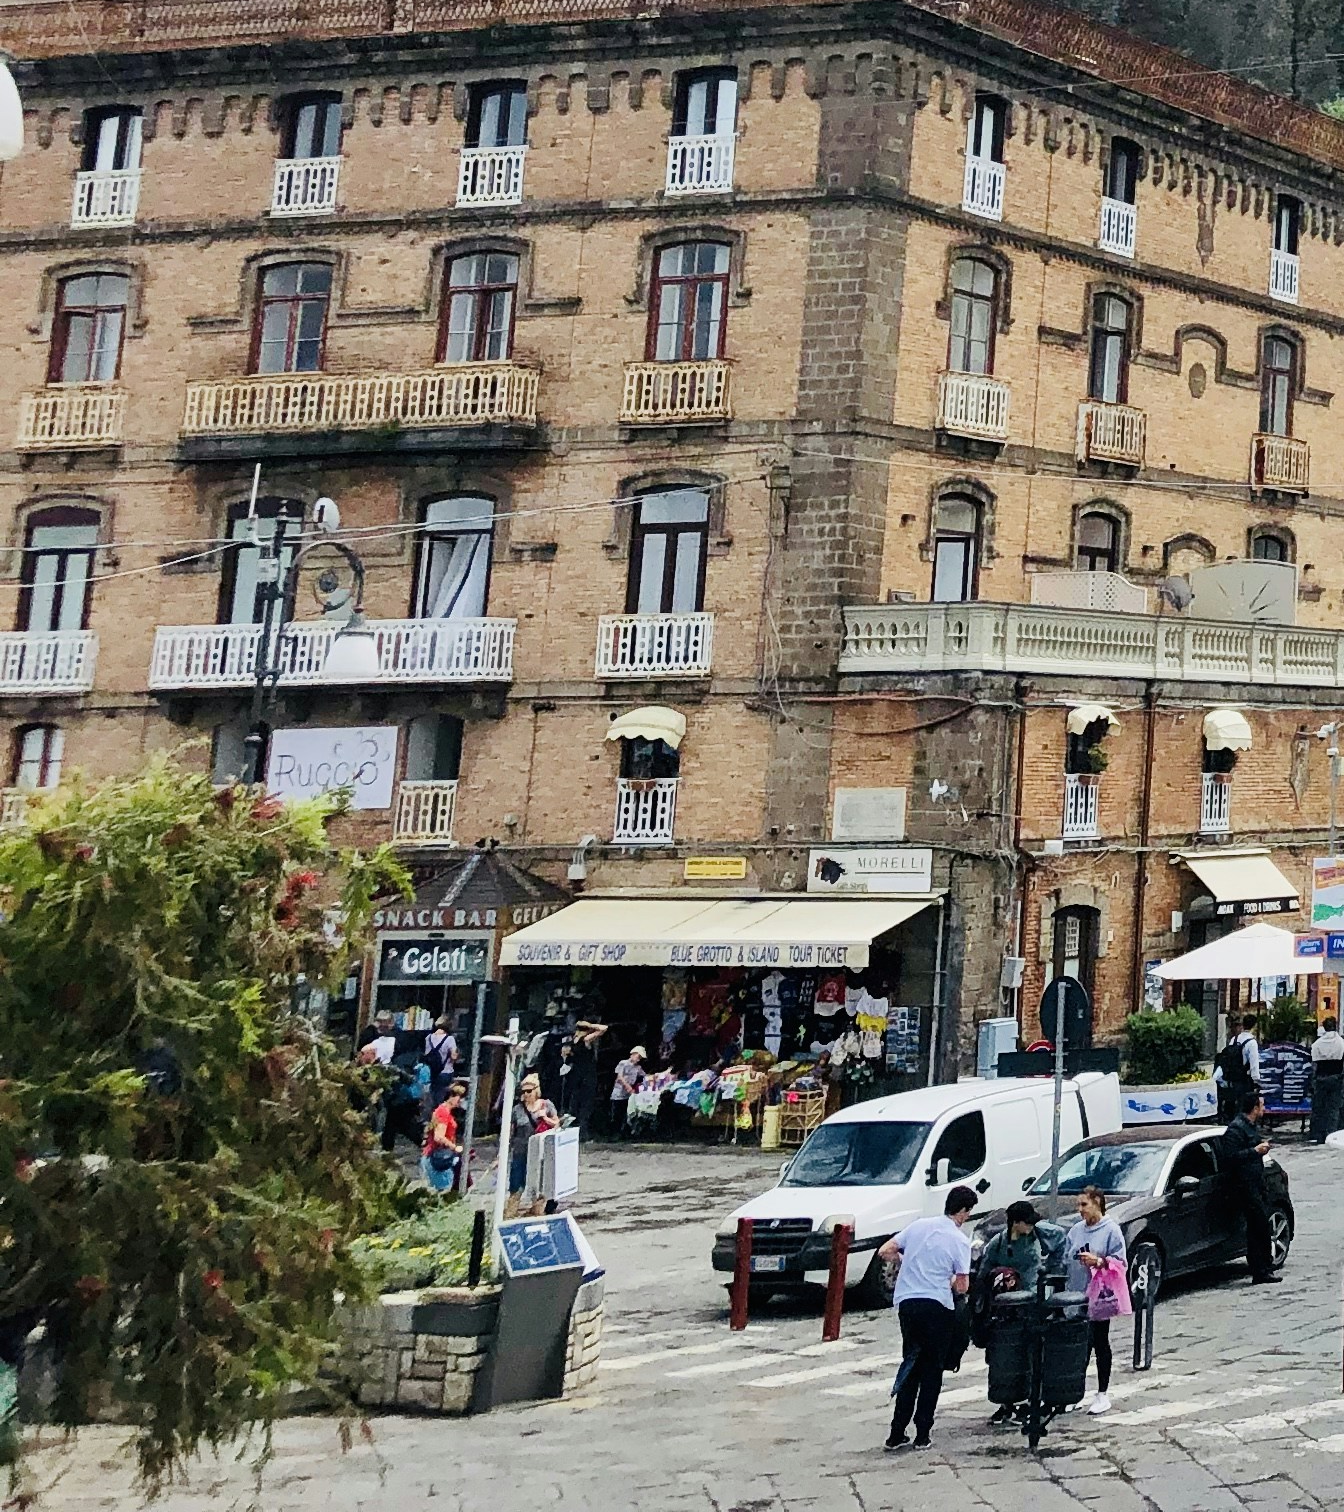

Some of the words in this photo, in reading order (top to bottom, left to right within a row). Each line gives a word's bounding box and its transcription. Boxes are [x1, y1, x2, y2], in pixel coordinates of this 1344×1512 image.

[857, 856, 925, 870] MORELLI
[373, 909, 445, 927] SNACK
[453, 909, 497, 927] BAR
[402, 944, 467, 974] Gelati
[517, 944, 562, 961] SOUVENIR
[564, 944, 571, 961] &
[578, 944, 599, 962] GIFT
[601, 944, 627, 962] SHOP
[670, 945, 694, 963] BLUE
[697, 945, 732, 963] GROTTO
[738, 945, 744, 963] &
[748, 946, 780, 963] ISLAND
[789, 946, 813, 963] TOUR
[817, 946, 849, 964] TICKET
